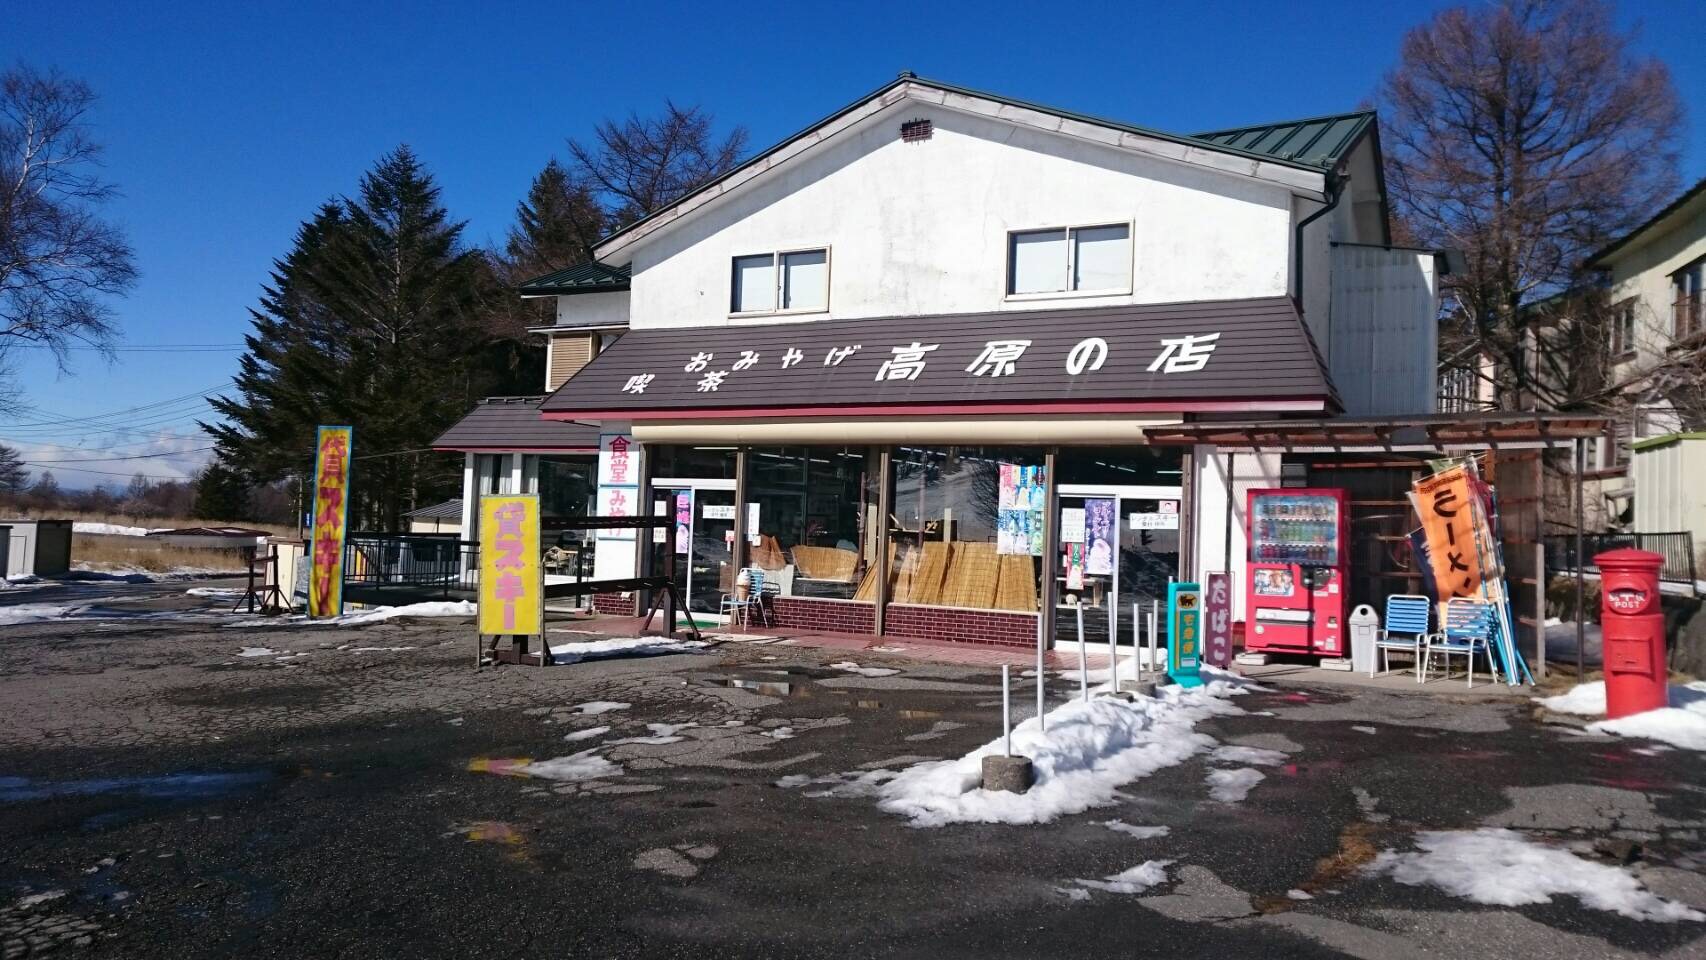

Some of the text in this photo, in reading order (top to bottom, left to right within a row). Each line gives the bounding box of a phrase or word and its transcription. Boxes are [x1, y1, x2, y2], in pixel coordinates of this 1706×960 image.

[684, 344, 862, 374] おみやげ
[874, 331, 1222, 383] 高原の店
[621, 369, 729, 394] 喫茶
[608, 435, 631, 483] 食堂
[315, 437, 347, 614] 貸スキー
[608, 489, 628, 537] みや
[492, 502, 528, 630] 貸スキー
[1211, 578, 1229, 661] たばこ
[1614, 601, 1640, 609] POST
